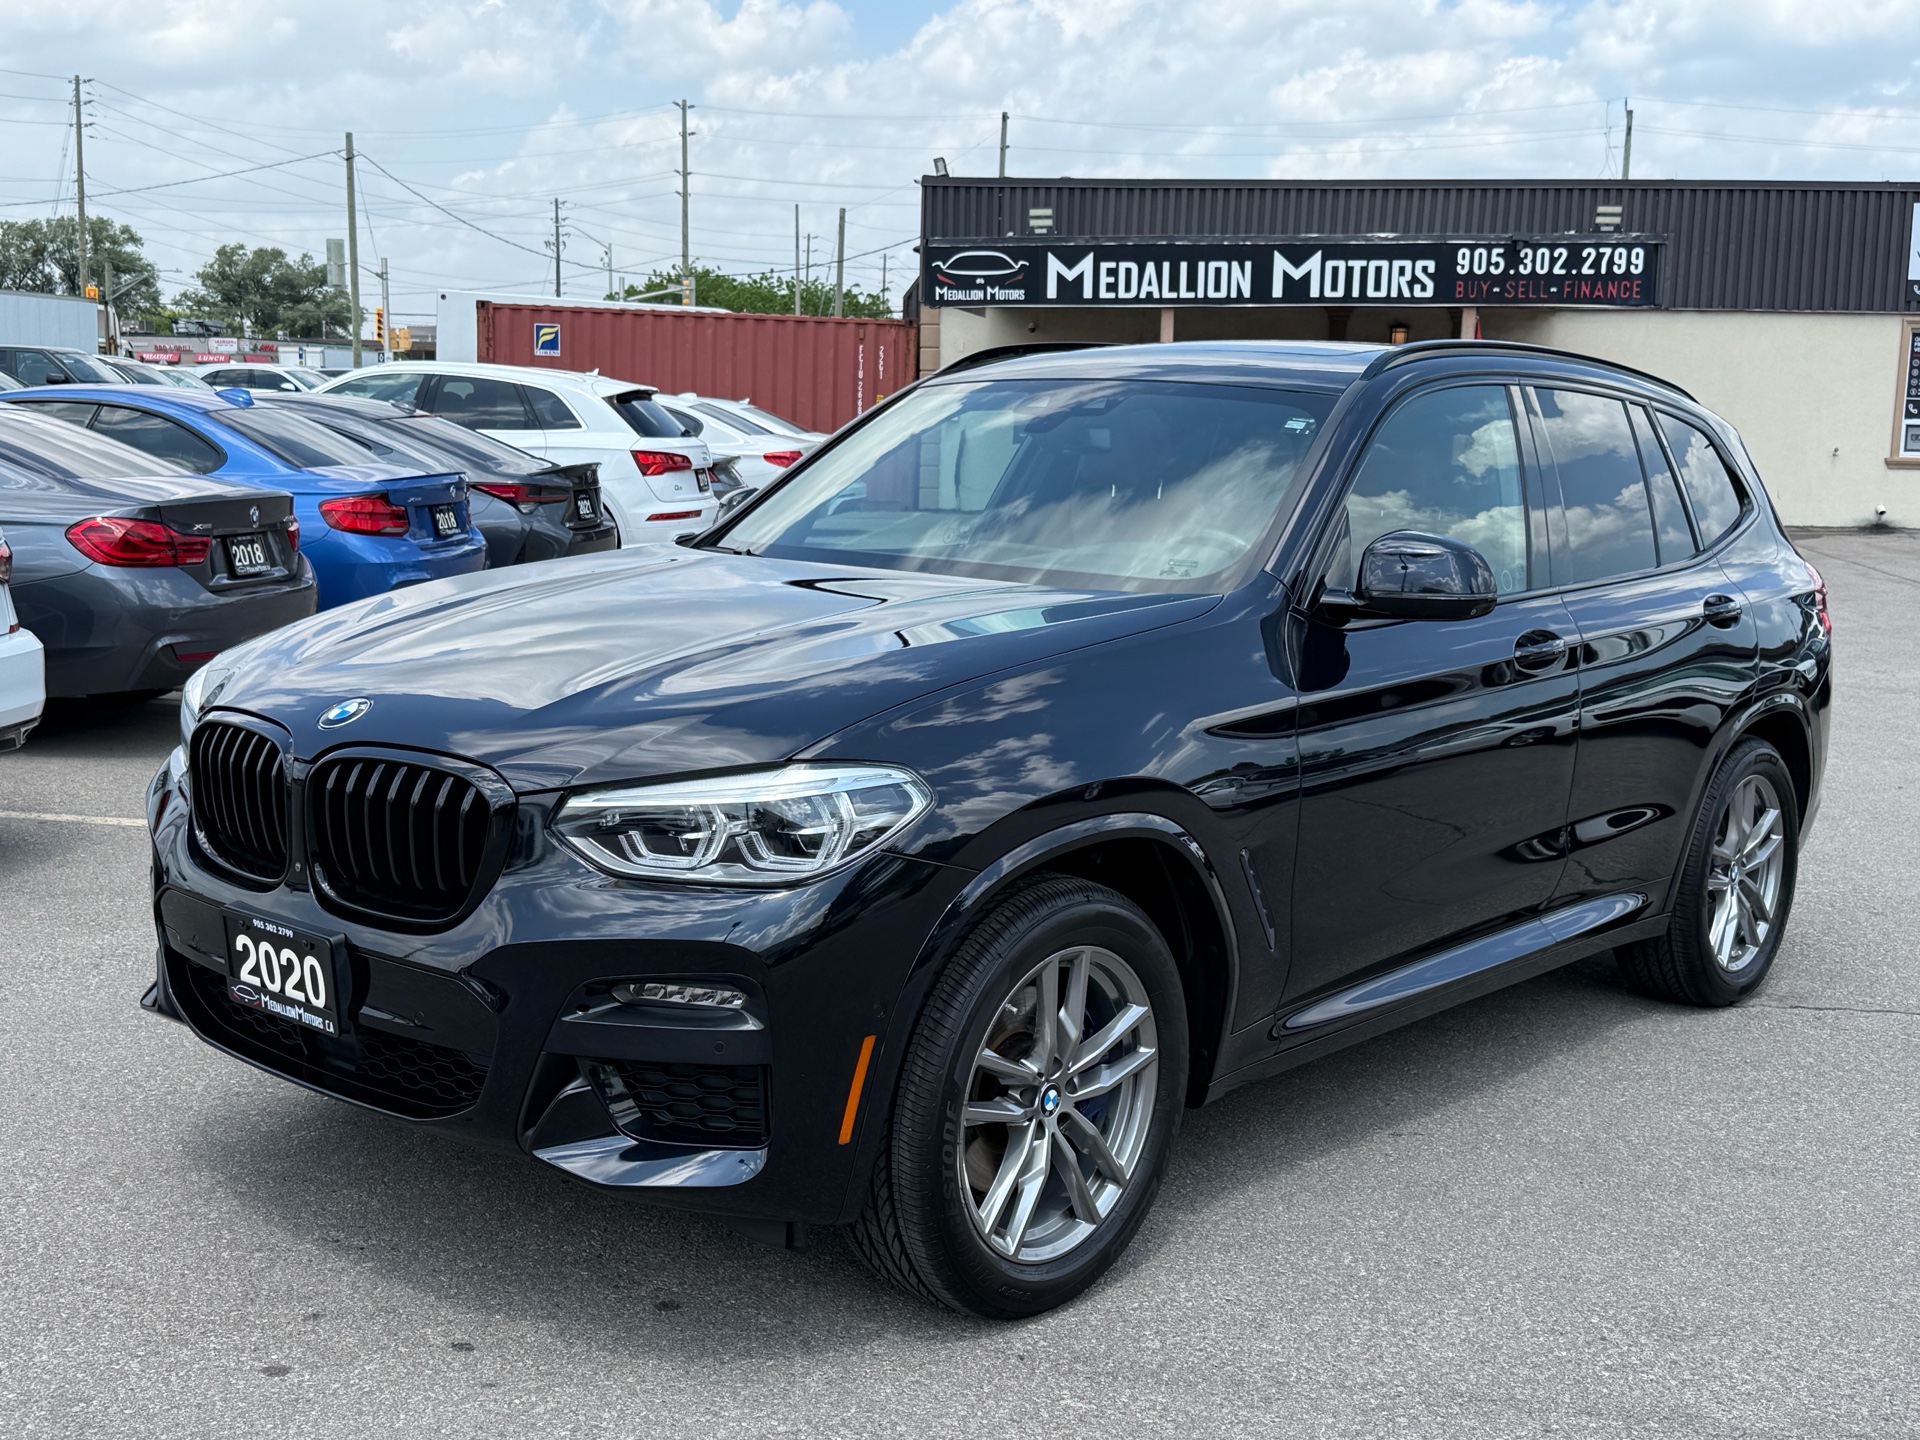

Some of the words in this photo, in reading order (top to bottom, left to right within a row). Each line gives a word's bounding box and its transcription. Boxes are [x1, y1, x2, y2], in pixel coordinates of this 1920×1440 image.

[1456, 247, 1645, 275] 905.302.2799
[1046, 251, 1252, 299] MEDALLION
[1272, 249, 1436, 298] MOTORS
[935, 285, 984, 301] MEDALLION
[986, 285, 1026, 301] MOTORS
[1455, 281, 1492, 299] BUY
[1504, 281, 1548, 299] SELL
[1563, 280, 1642, 299] FINANCE
[436, 511, 457, 529] 2018
[233, 543, 264, 566] 2018
[252, 919, 265, 930] 905
[265, 923, 278, 934] 302
[278, 928, 294, 939] 2799
[236, 934, 326, 1008] 2020
